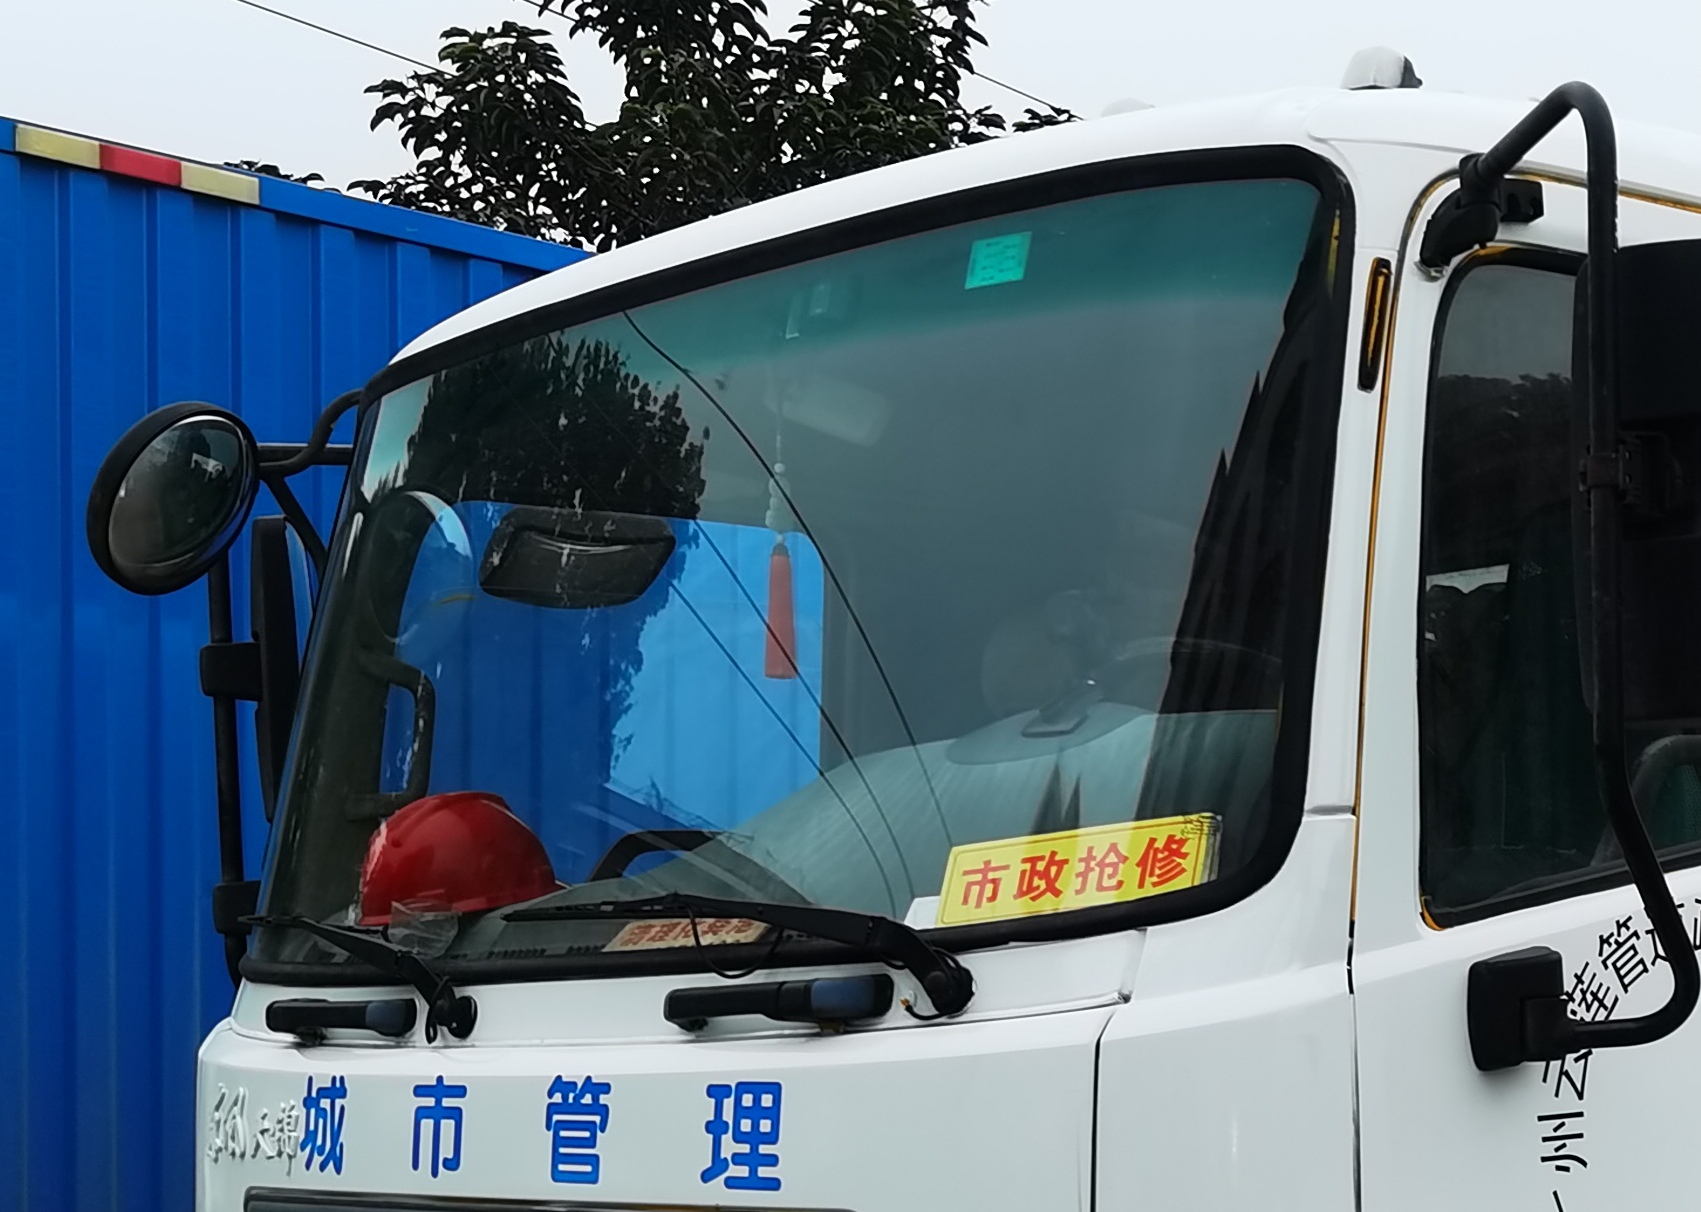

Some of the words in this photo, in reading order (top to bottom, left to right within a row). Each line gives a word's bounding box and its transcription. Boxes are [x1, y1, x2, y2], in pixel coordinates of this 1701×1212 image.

[961, 834, 1191, 911] 市政抢修
[299, 1074, 783, 1191] 城市管理
